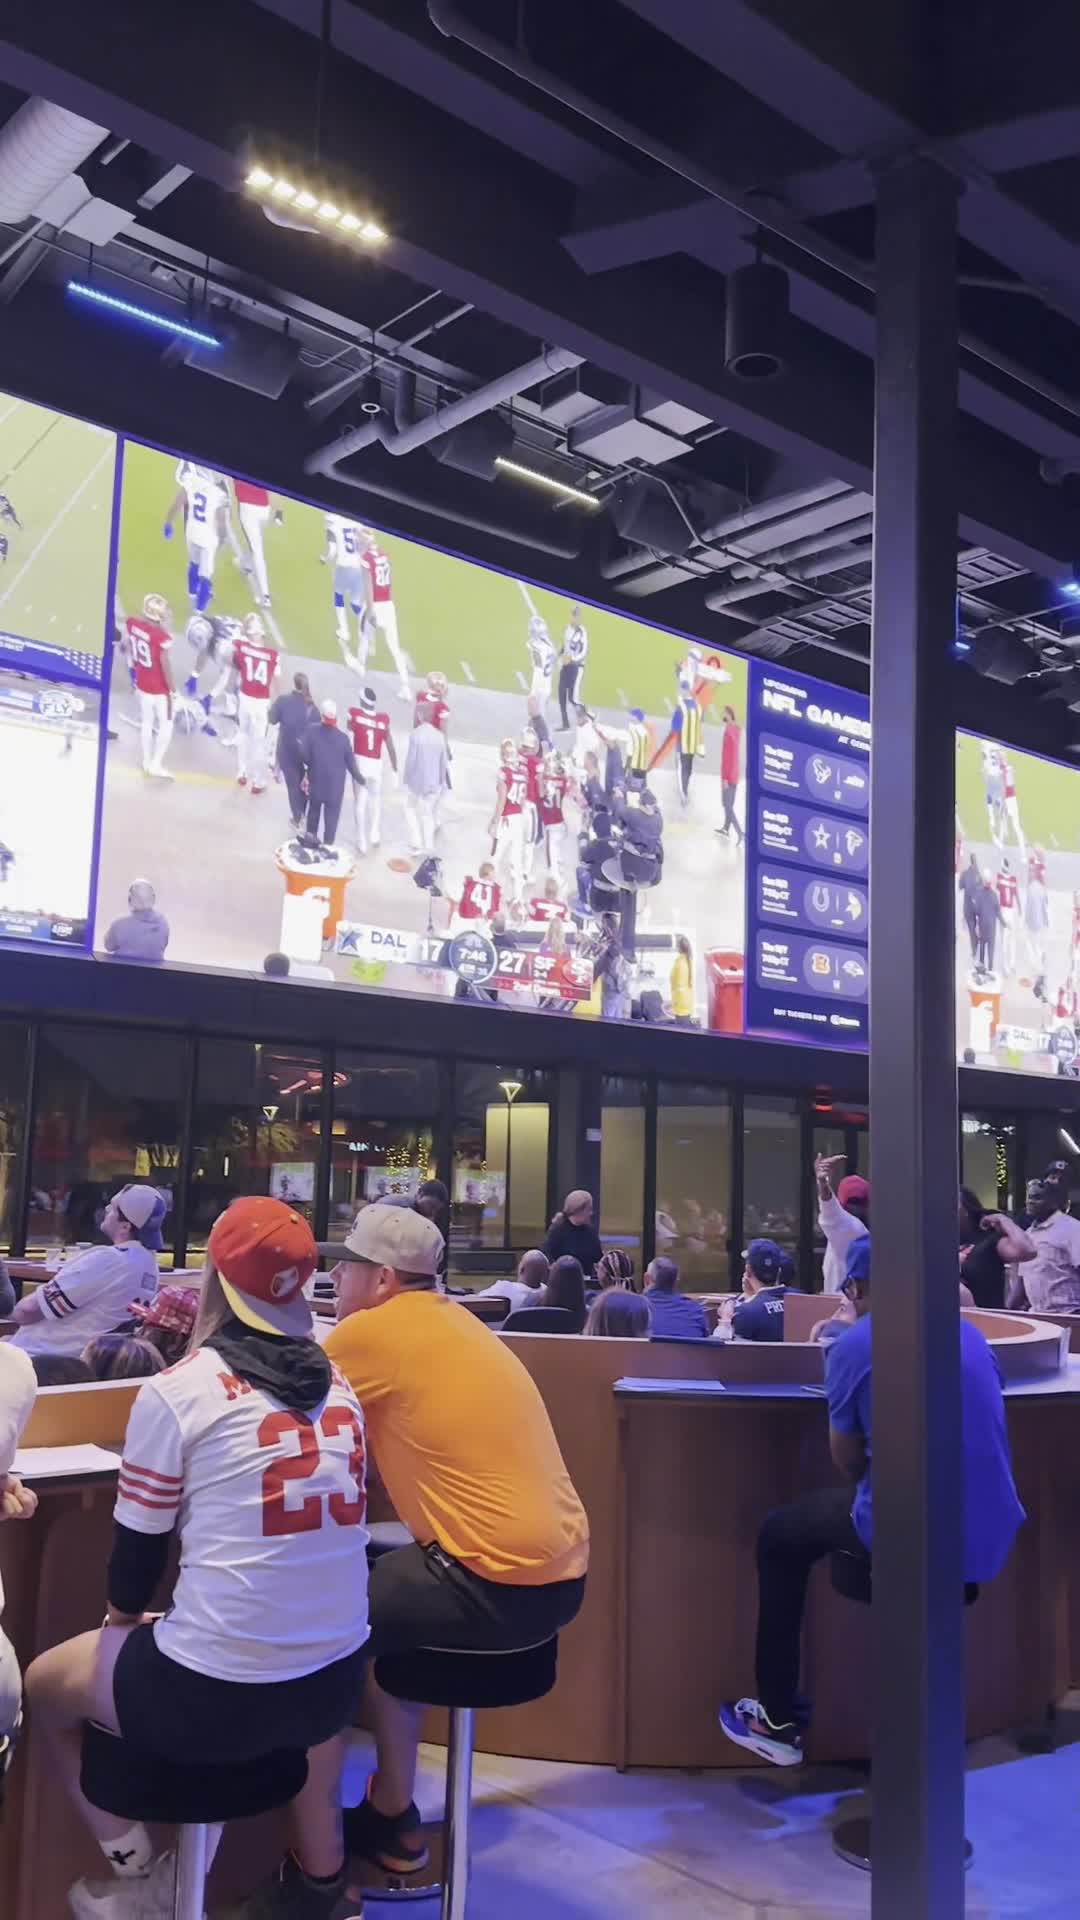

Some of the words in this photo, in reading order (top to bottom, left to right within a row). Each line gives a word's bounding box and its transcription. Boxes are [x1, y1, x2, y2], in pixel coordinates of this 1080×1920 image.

[193, 492, 207, 522] 2
[244, 655, 268, 686] 14
[763, 689, 802, 718] NFL
[366, 729, 375, 750] 1
[371, 931, 407, 948] DAL
[421, 939, 445, 962] 17
[499, 950, 525, 974] 27
[534, 955, 556, 971] SF
[257, 1406, 367, 1536] 23
